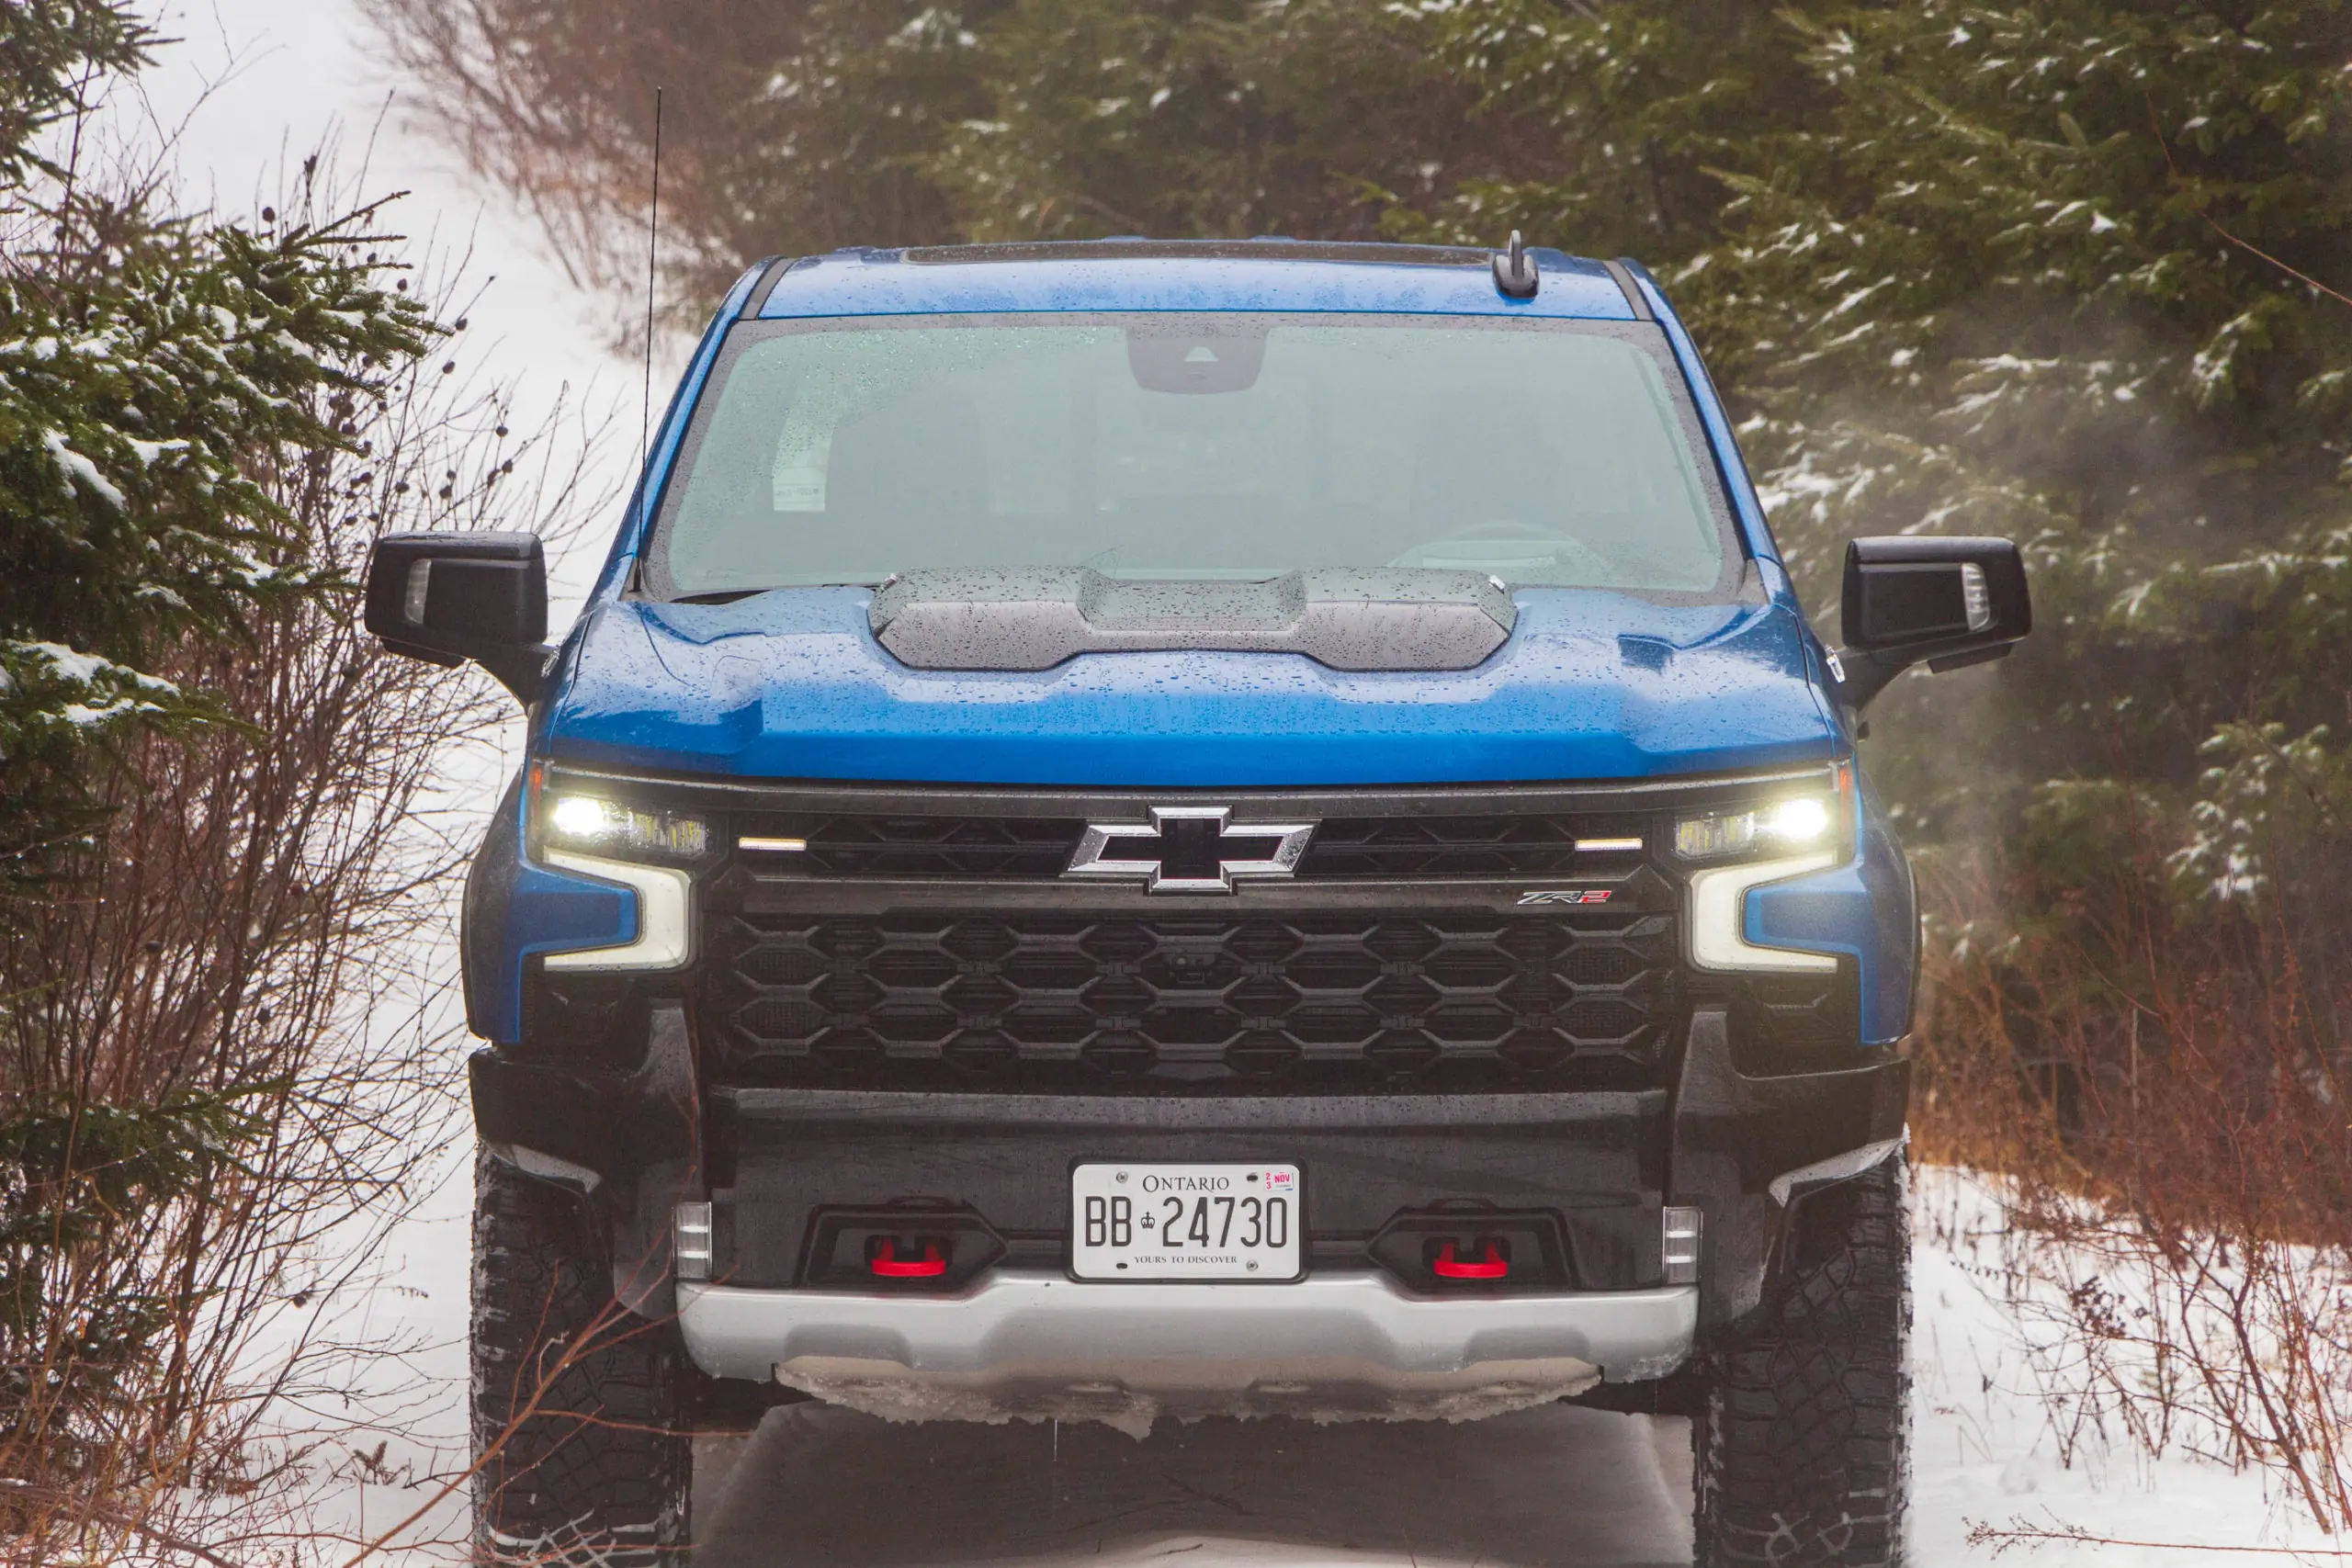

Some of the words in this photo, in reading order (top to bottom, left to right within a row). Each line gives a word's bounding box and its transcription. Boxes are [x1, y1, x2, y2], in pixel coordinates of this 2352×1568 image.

[1517, 889, 1612, 905] ZR2
[1142, 1174, 1230, 1193] ONTARIO
[1274, 1174, 1290, 1183] NOV
[1162, 1196, 1287, 1248] 24730
[1134, 1256, 1167, 1264] YOURS
[1171, 1256, 1184, 1264] TO
[1187, 1256, 1238, 1264] DISCOVER
